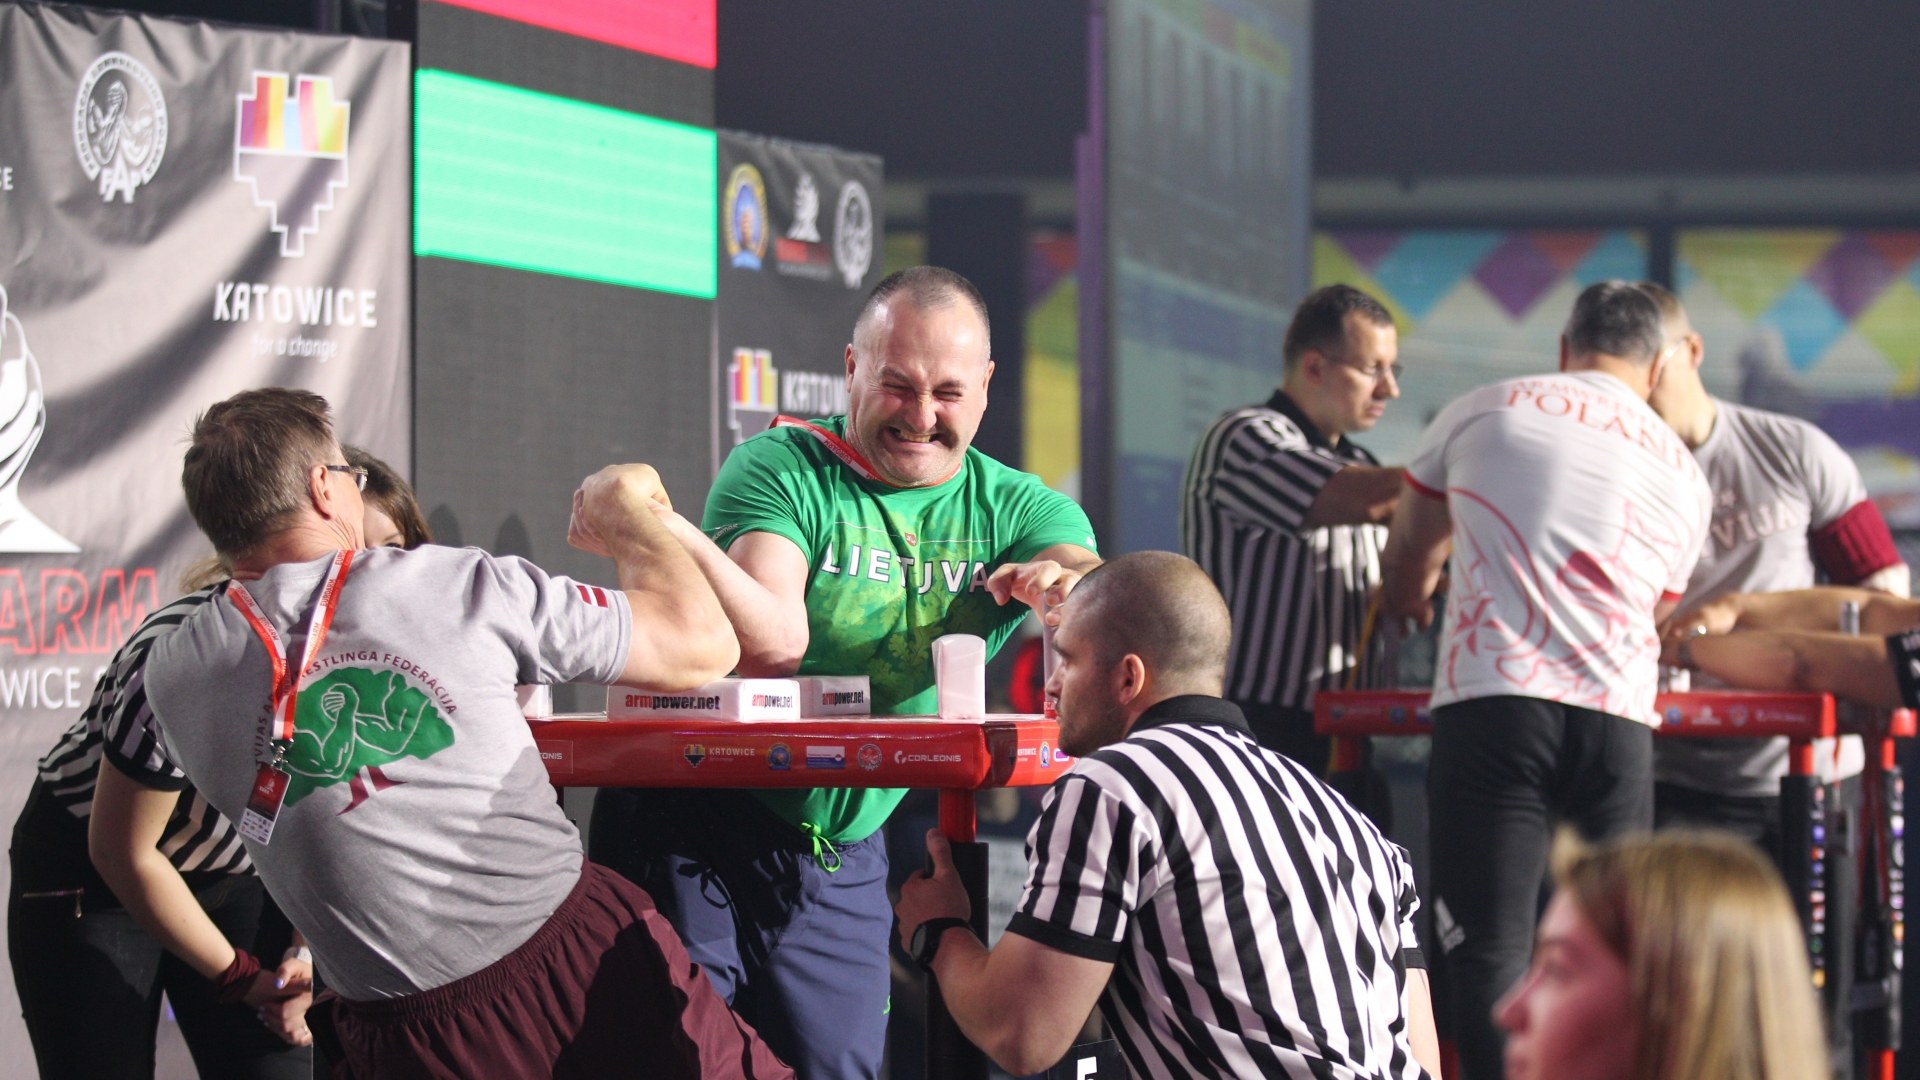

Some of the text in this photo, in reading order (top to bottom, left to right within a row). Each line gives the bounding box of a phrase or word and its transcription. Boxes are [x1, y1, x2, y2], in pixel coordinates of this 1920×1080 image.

[213, 282, 377, 328] KATOWICE
[782, 372, 848, 415] KATOW
[1507, 389, 1697, 482] POLAND
[1710, 500, 1799, 550] VIJA
[320, 578, 336, 607] EUROARM
[625, 693, 721, 711] armpower.net
[752, 693, 793, 708] armpower.net
[822, 690, 864, 706] armpower.net
[709, 747, 756, 757] KATOWICE
[908, 753, 962, 763] CORLEONIS
